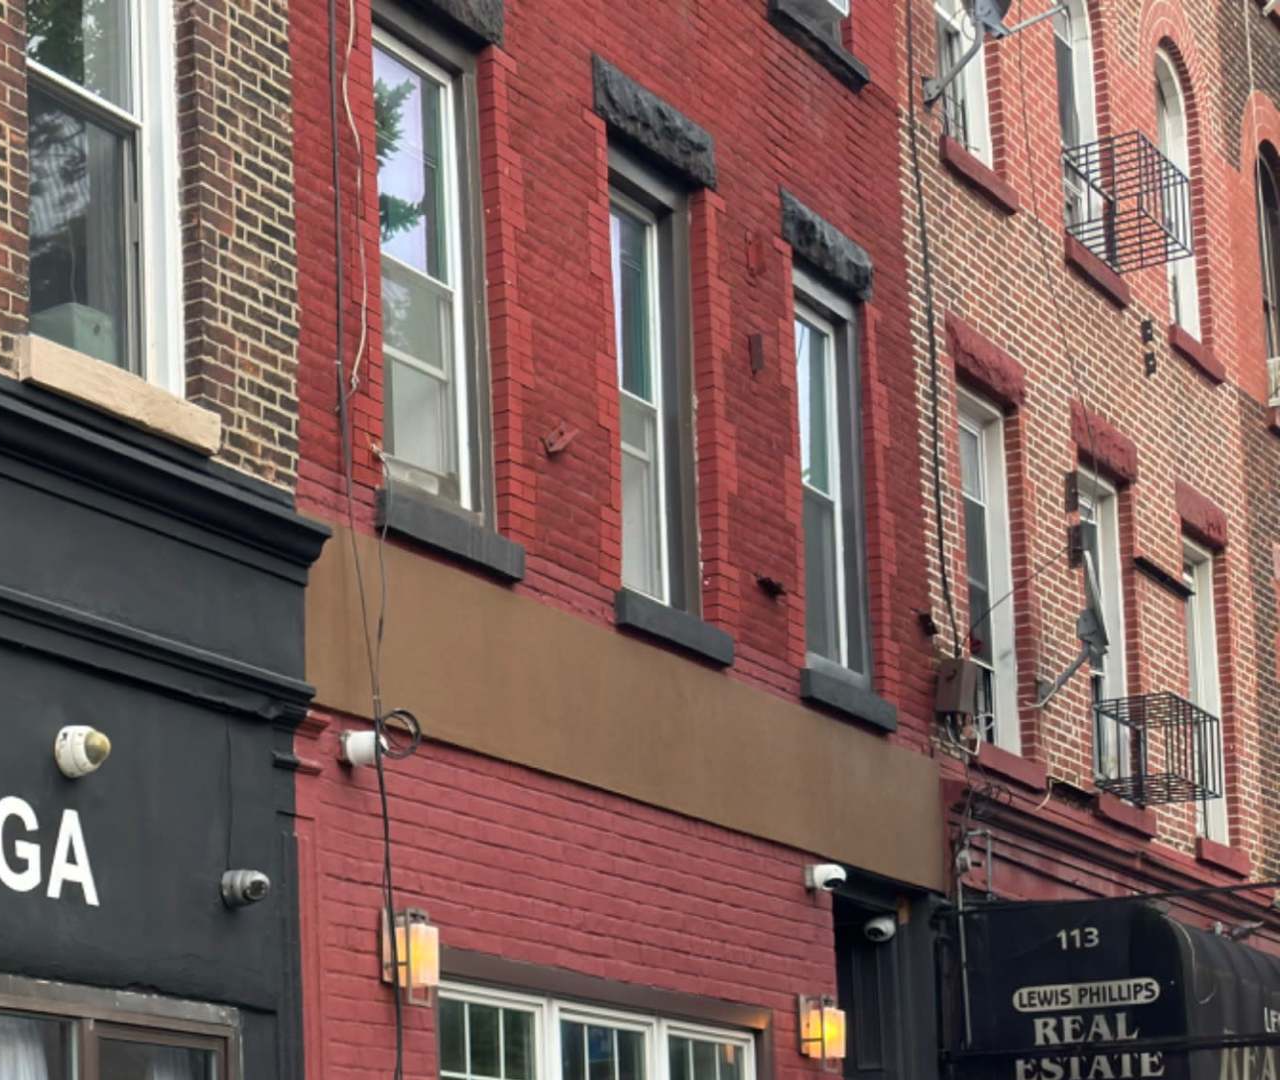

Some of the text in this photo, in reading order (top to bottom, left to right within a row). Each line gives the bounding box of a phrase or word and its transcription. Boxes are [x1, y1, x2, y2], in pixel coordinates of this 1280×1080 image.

[1056, 926, 1100, 950] 113
[1018, 981, 1157, 1009] LEWIS PHILLIPS
[1033, 1012, 1139, 1046] REAL
